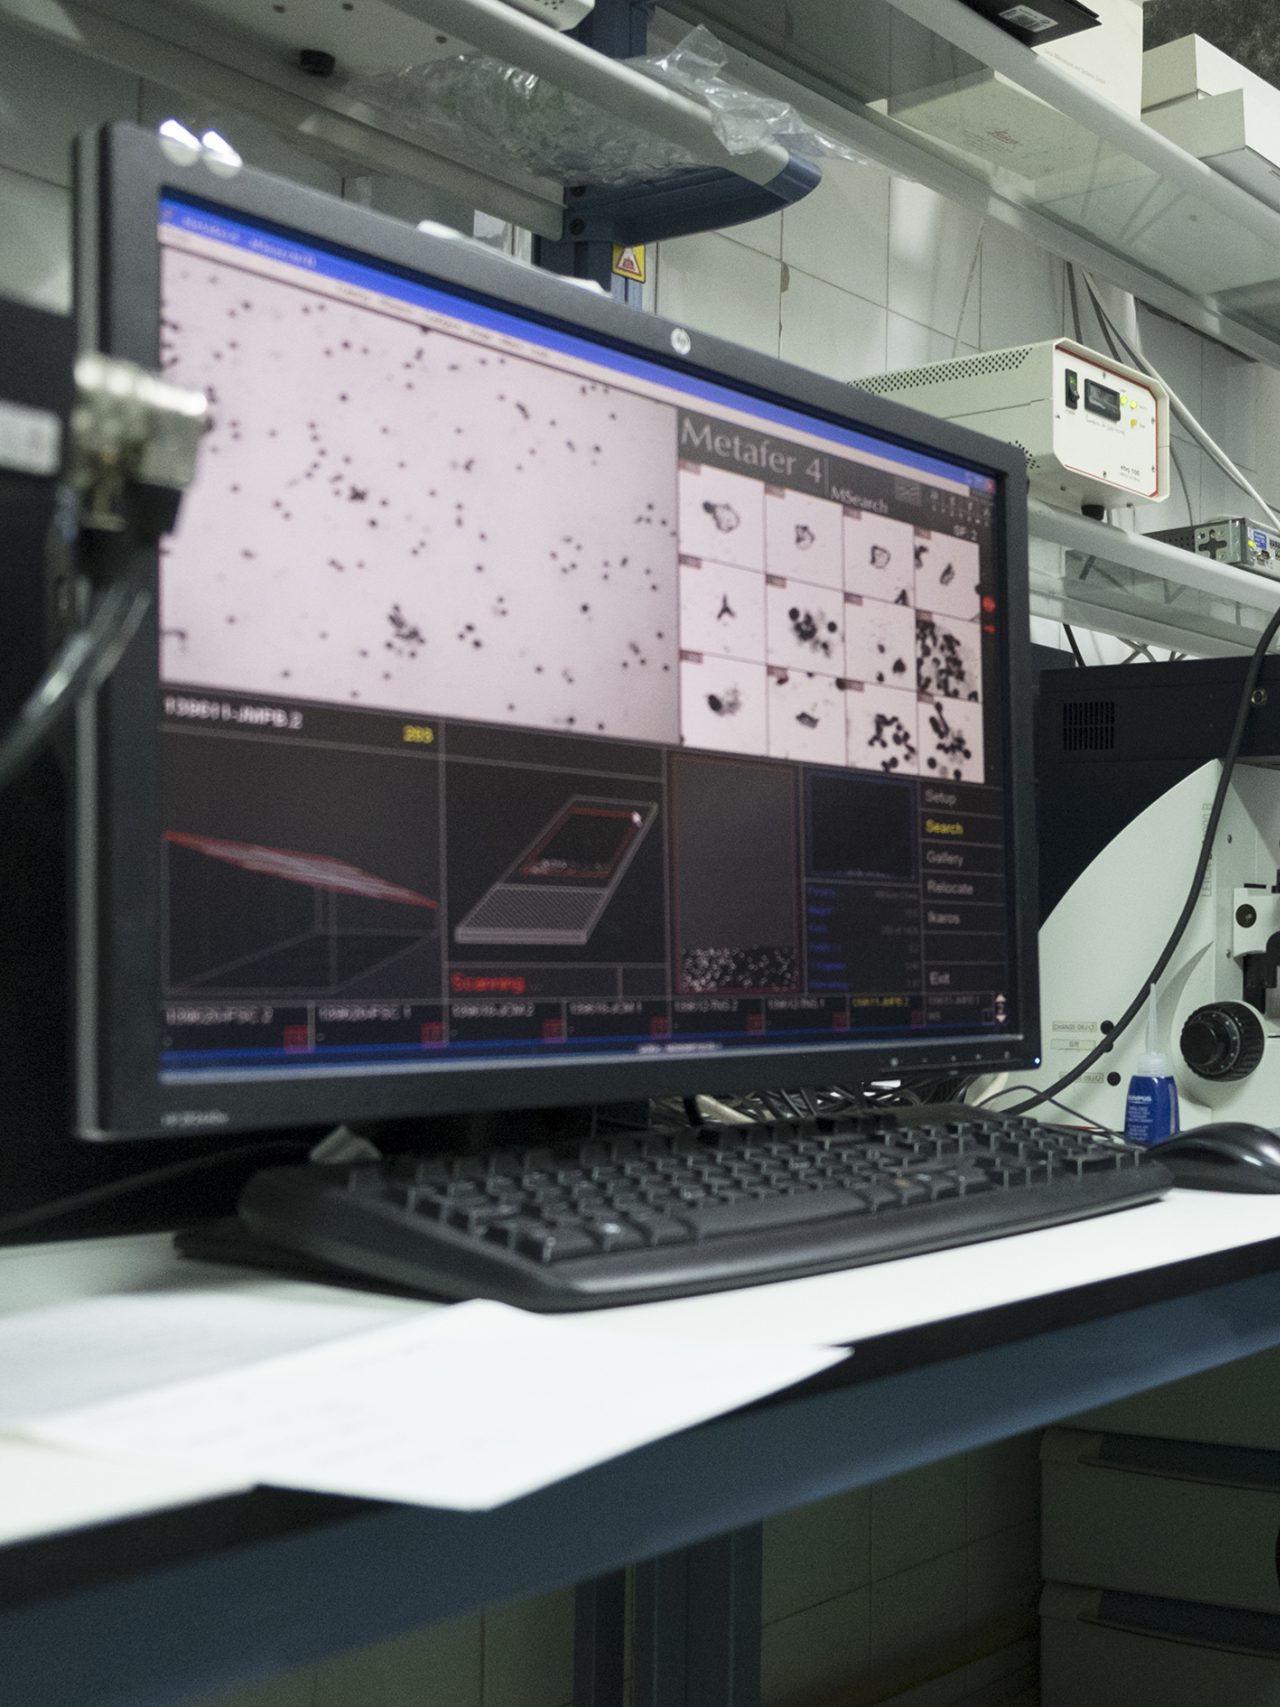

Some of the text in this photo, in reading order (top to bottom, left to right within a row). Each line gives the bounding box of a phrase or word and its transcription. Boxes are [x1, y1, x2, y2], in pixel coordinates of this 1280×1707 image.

[680, 417, 823, 483] Metafer 4
[831, 485, 889, 514] MSearch
[925, 789, 957, 807] Setup
[926, 818, 964, 835] Search
[927, 850, 963, 868] Gallery
[927, 879, 974, 895] Relocate
[929, 971, 950, 986] Exit
